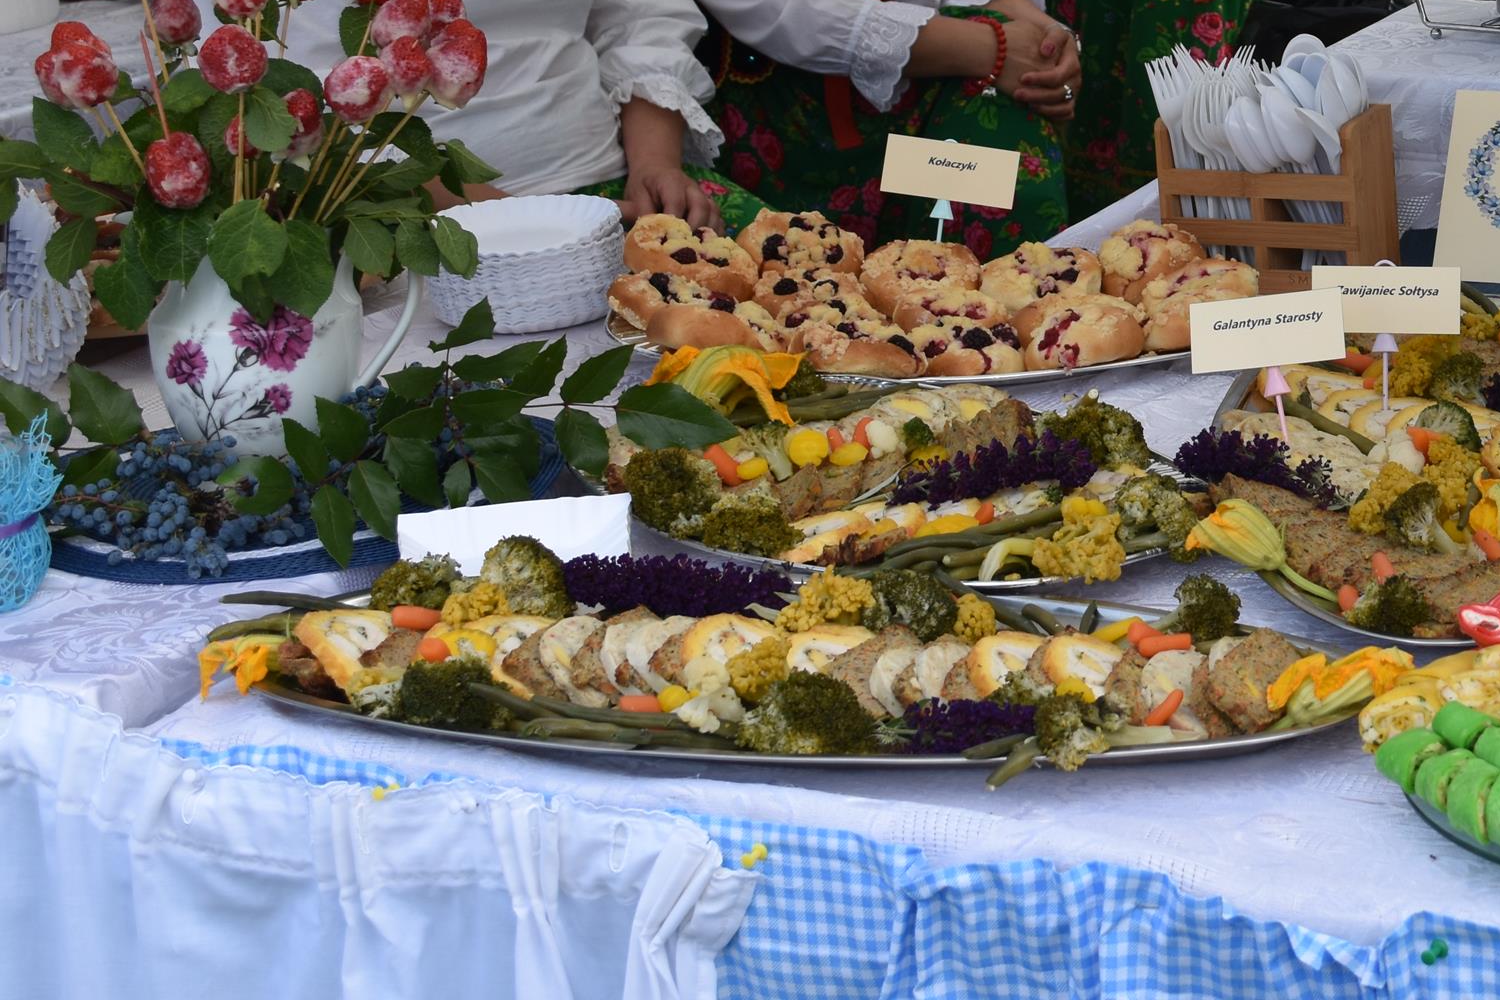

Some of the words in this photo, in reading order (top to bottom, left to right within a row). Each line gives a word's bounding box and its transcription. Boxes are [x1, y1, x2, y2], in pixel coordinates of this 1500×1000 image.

[928, 156, 977, 171] Kołaczyki
[1398, 285, 1440, 299] Sołtysa
[1213, 317, 1272, 331] Galantyna
[1274, 310, 1324, 325] Starosty
